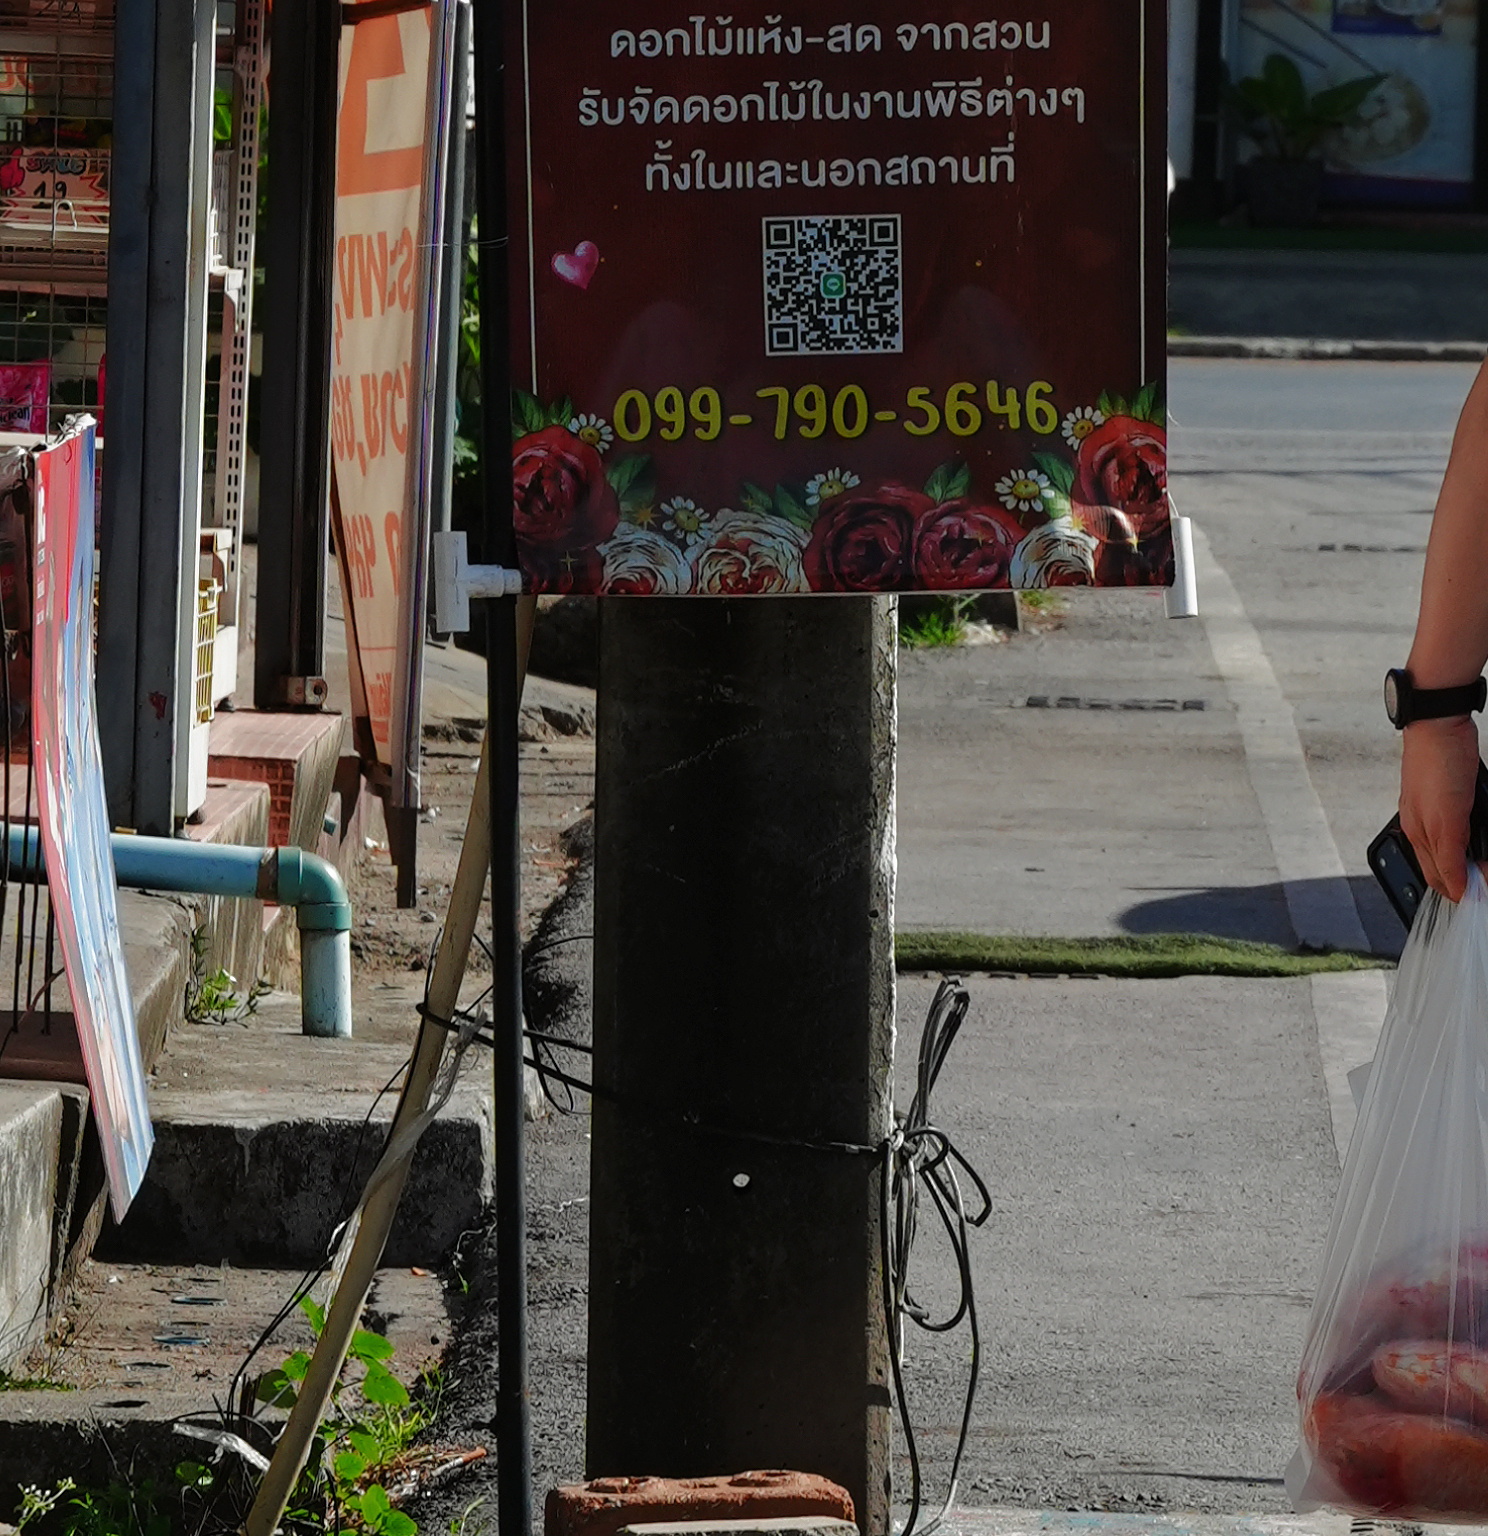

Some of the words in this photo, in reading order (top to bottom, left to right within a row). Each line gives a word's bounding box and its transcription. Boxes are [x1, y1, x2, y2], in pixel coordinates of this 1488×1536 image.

[609, 15, 883, 58] ดอกไม้แห้ง-สด
[896, 16, 1052, 52] จากสวน
[577, 77, 1087, 127] รับจัดดอกไม้ในงานพิธีต่างๆ
[644, 132, 1016, 191] ทั้งในและนอกสถานที่
[612, 380, 1060, 442] 099-790-5646
